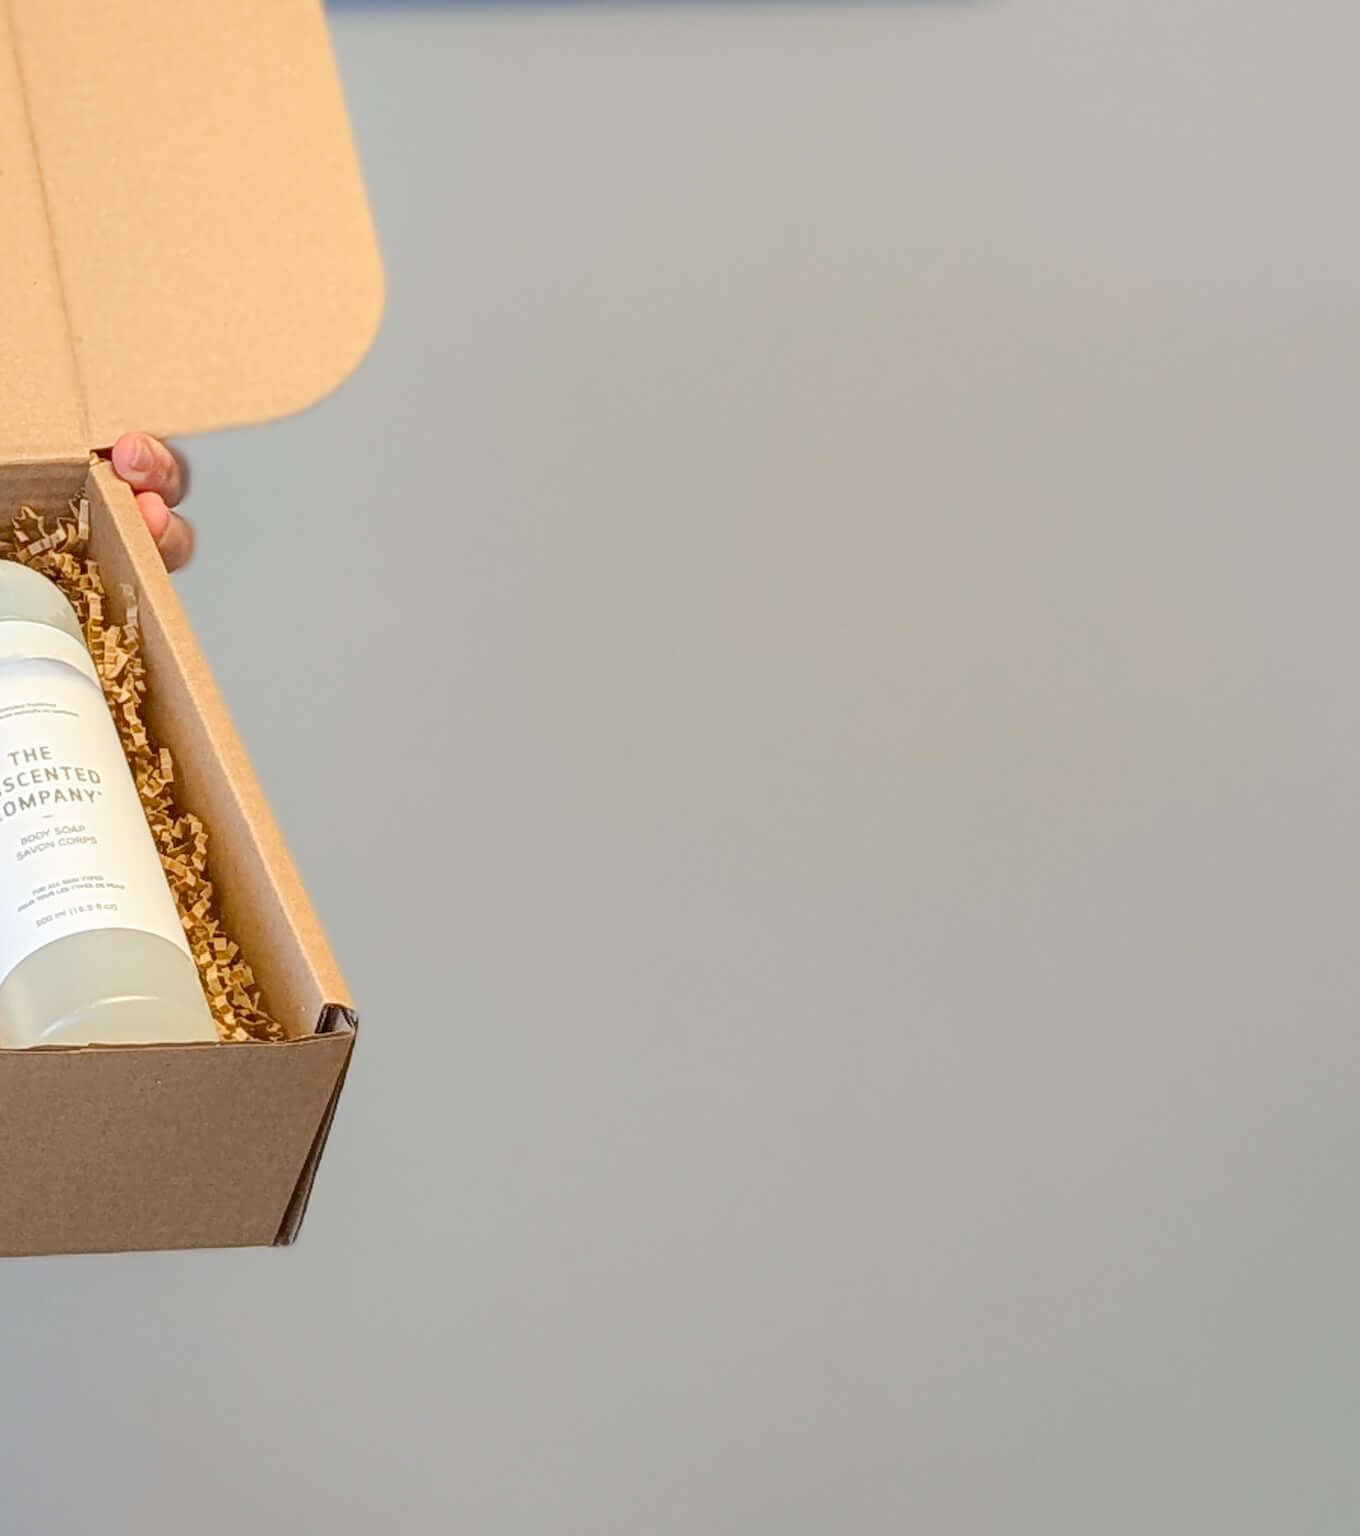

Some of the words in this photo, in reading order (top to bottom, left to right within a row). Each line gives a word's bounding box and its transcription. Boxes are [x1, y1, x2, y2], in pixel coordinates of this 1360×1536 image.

[8, 746, 52, 767] THE
[20, 827, 51, 847] BODY
[54, 824, 86, 837] SOAP
[16, 840, 55, 862] SAVON
[58, 835, 98, 847] CORPS
